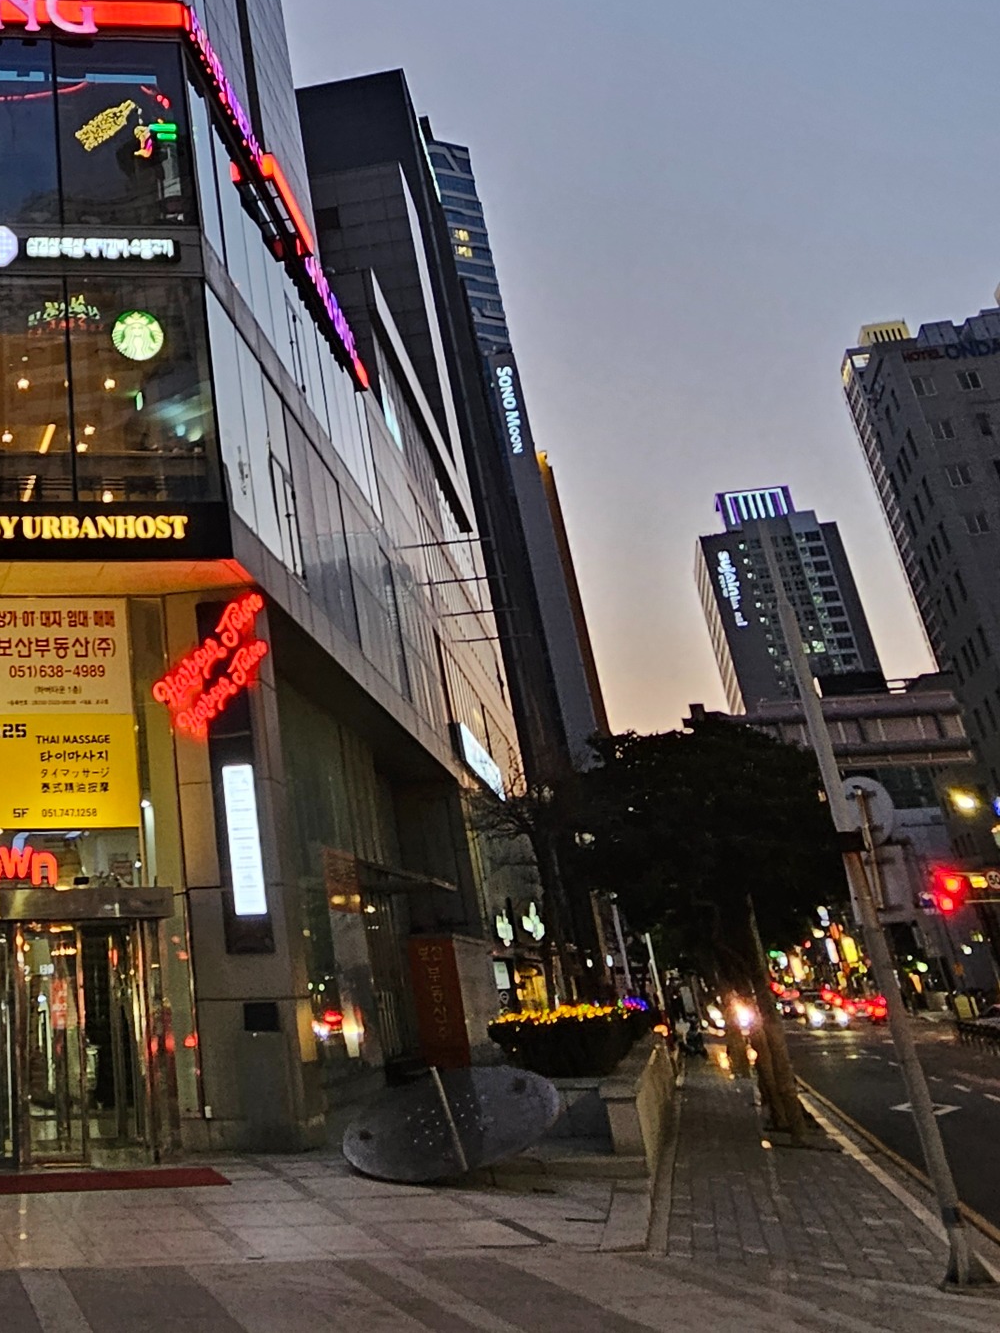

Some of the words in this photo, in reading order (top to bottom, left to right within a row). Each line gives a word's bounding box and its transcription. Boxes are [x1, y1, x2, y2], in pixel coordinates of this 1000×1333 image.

[496, 366, 517, 410] SONO
[22, 515, 187, 540] URBANHOST
[153, 638, 227, 708] Harbour
[215, 593, 263, 647] Town
[227, 641, 267, 685] Town
[9, 664, 105, 678] 051)638-4989
[35, 734, 60, 744] THAI
[62, 734, 111, 744] MASSAGE
[40, 750, 109, 762] 타이마사지
[41, 767, 110, 778] タイマッサージ
[41, 808, 98, 818] 051.747.1258
